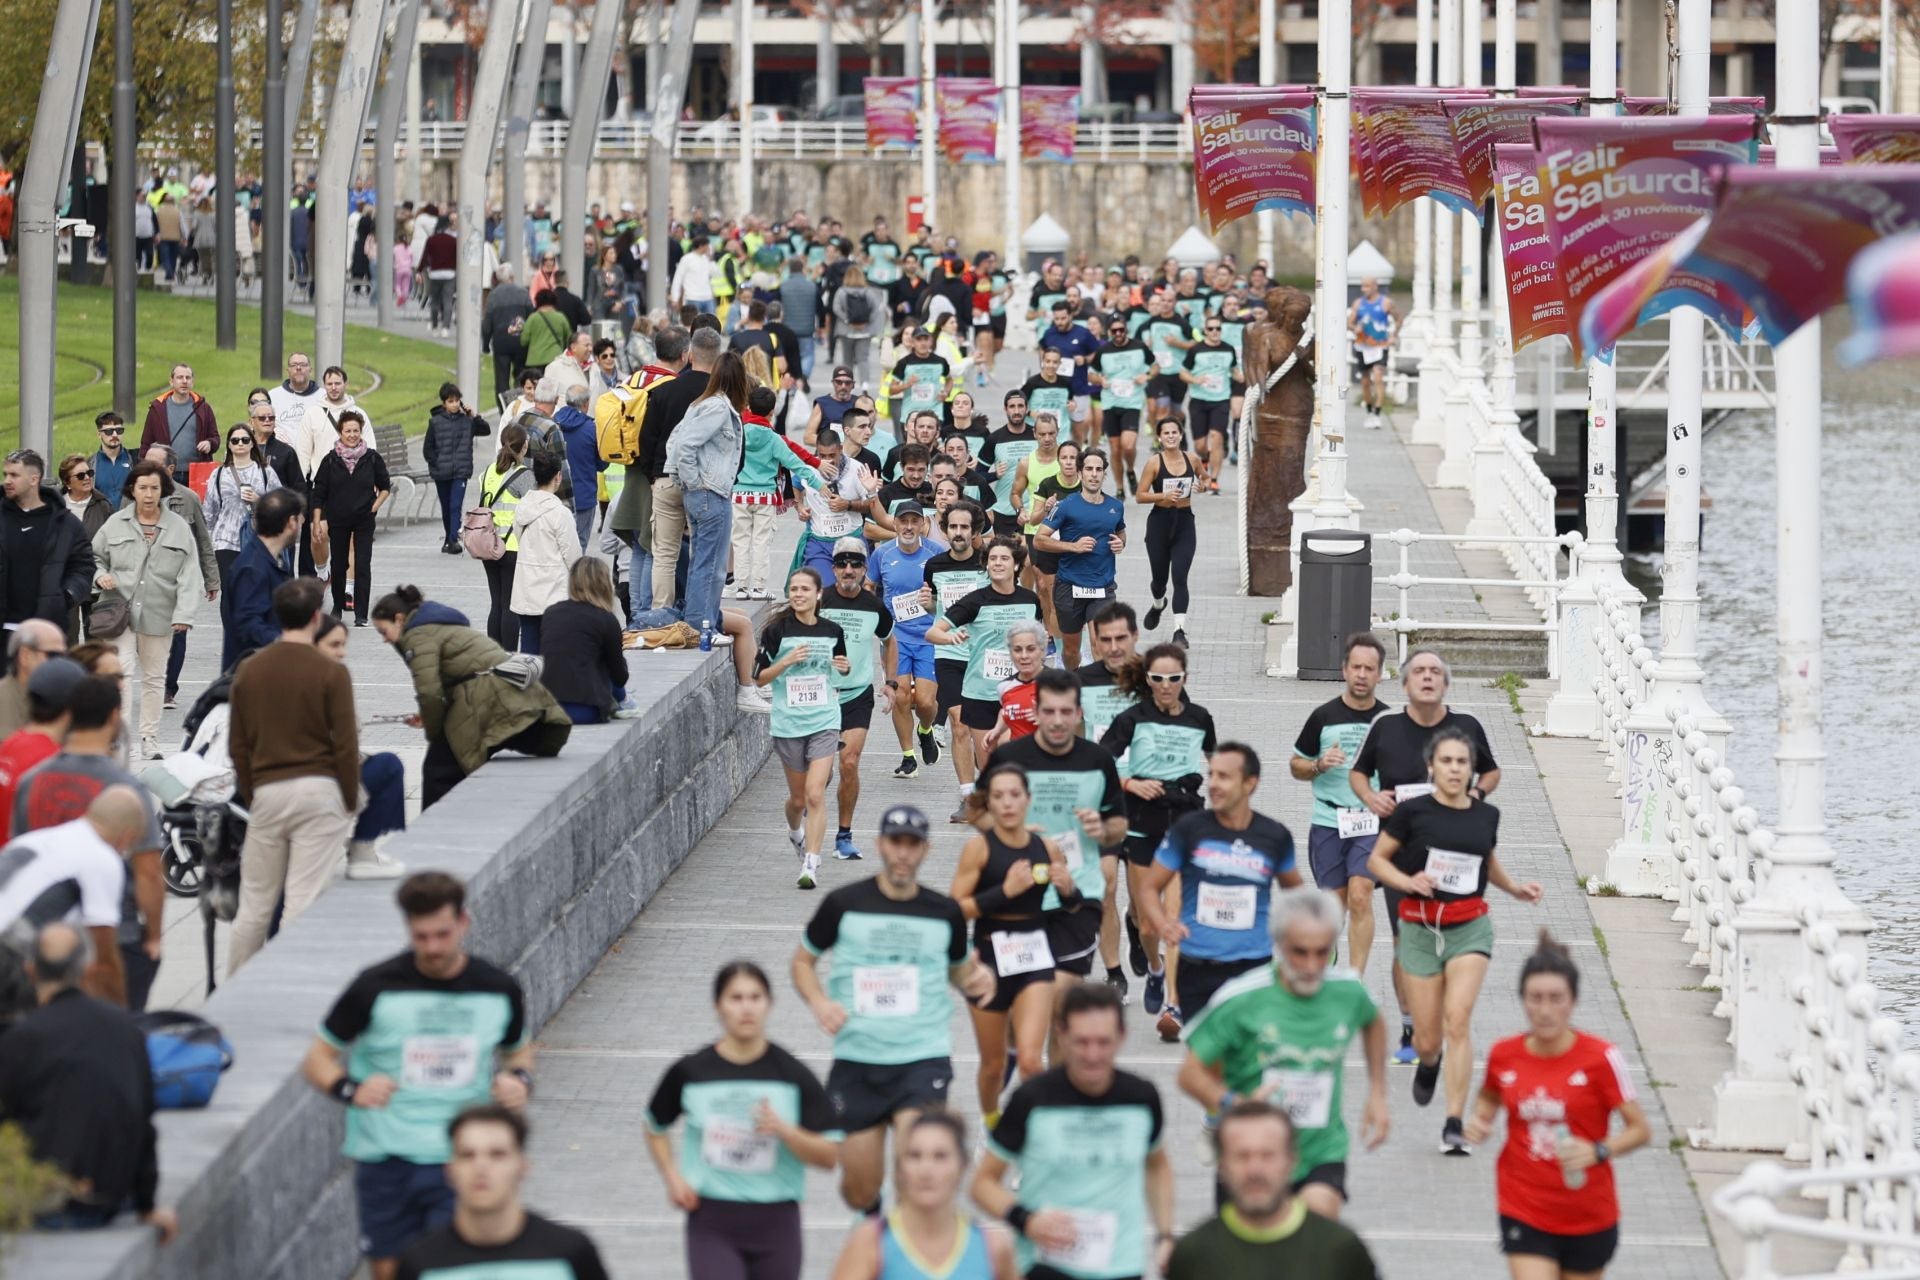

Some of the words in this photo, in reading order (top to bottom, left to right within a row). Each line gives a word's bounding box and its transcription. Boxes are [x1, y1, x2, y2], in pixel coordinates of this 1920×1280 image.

[1198, 110, 1241, 136] Fair
[1202, 125, 1312, 155] Saturday
[1206, 150, 1235, 169] Azaroak
[1236, 148, 1248, 156] 30
[1249, 146, 1294, 154] noviembre
[1548, 143, 1625, 188] Fair
[1503, 172, 1540, 202] Fa
[1554, 168, 1713, 222] Saturda
[1505, 201, 1545, 231] Sa
[1562, 214, 1610, 250] Azaroak
[1613, 206, 1631, 221] 30
[1509, 234, 1550, 254] Azaroak
[1511, 270, 1521, 281] Un
[1512, 278, 1532, 294] Egun
[1534, 272, 1554, 284] bat.
[1565, 266, 1580, 283] Un
[1569, 276, 1595, 298] Egun
[1595, 259, 1617, 279] bat.
[1532, 307, 1564, 321] WWW.FEST
[906, 606, 920, 615] 153
[994, 667, 1013, 676] 2120
[798, 692, 817, 701] 2138
[1352, 820, 1373, 831] 2077
